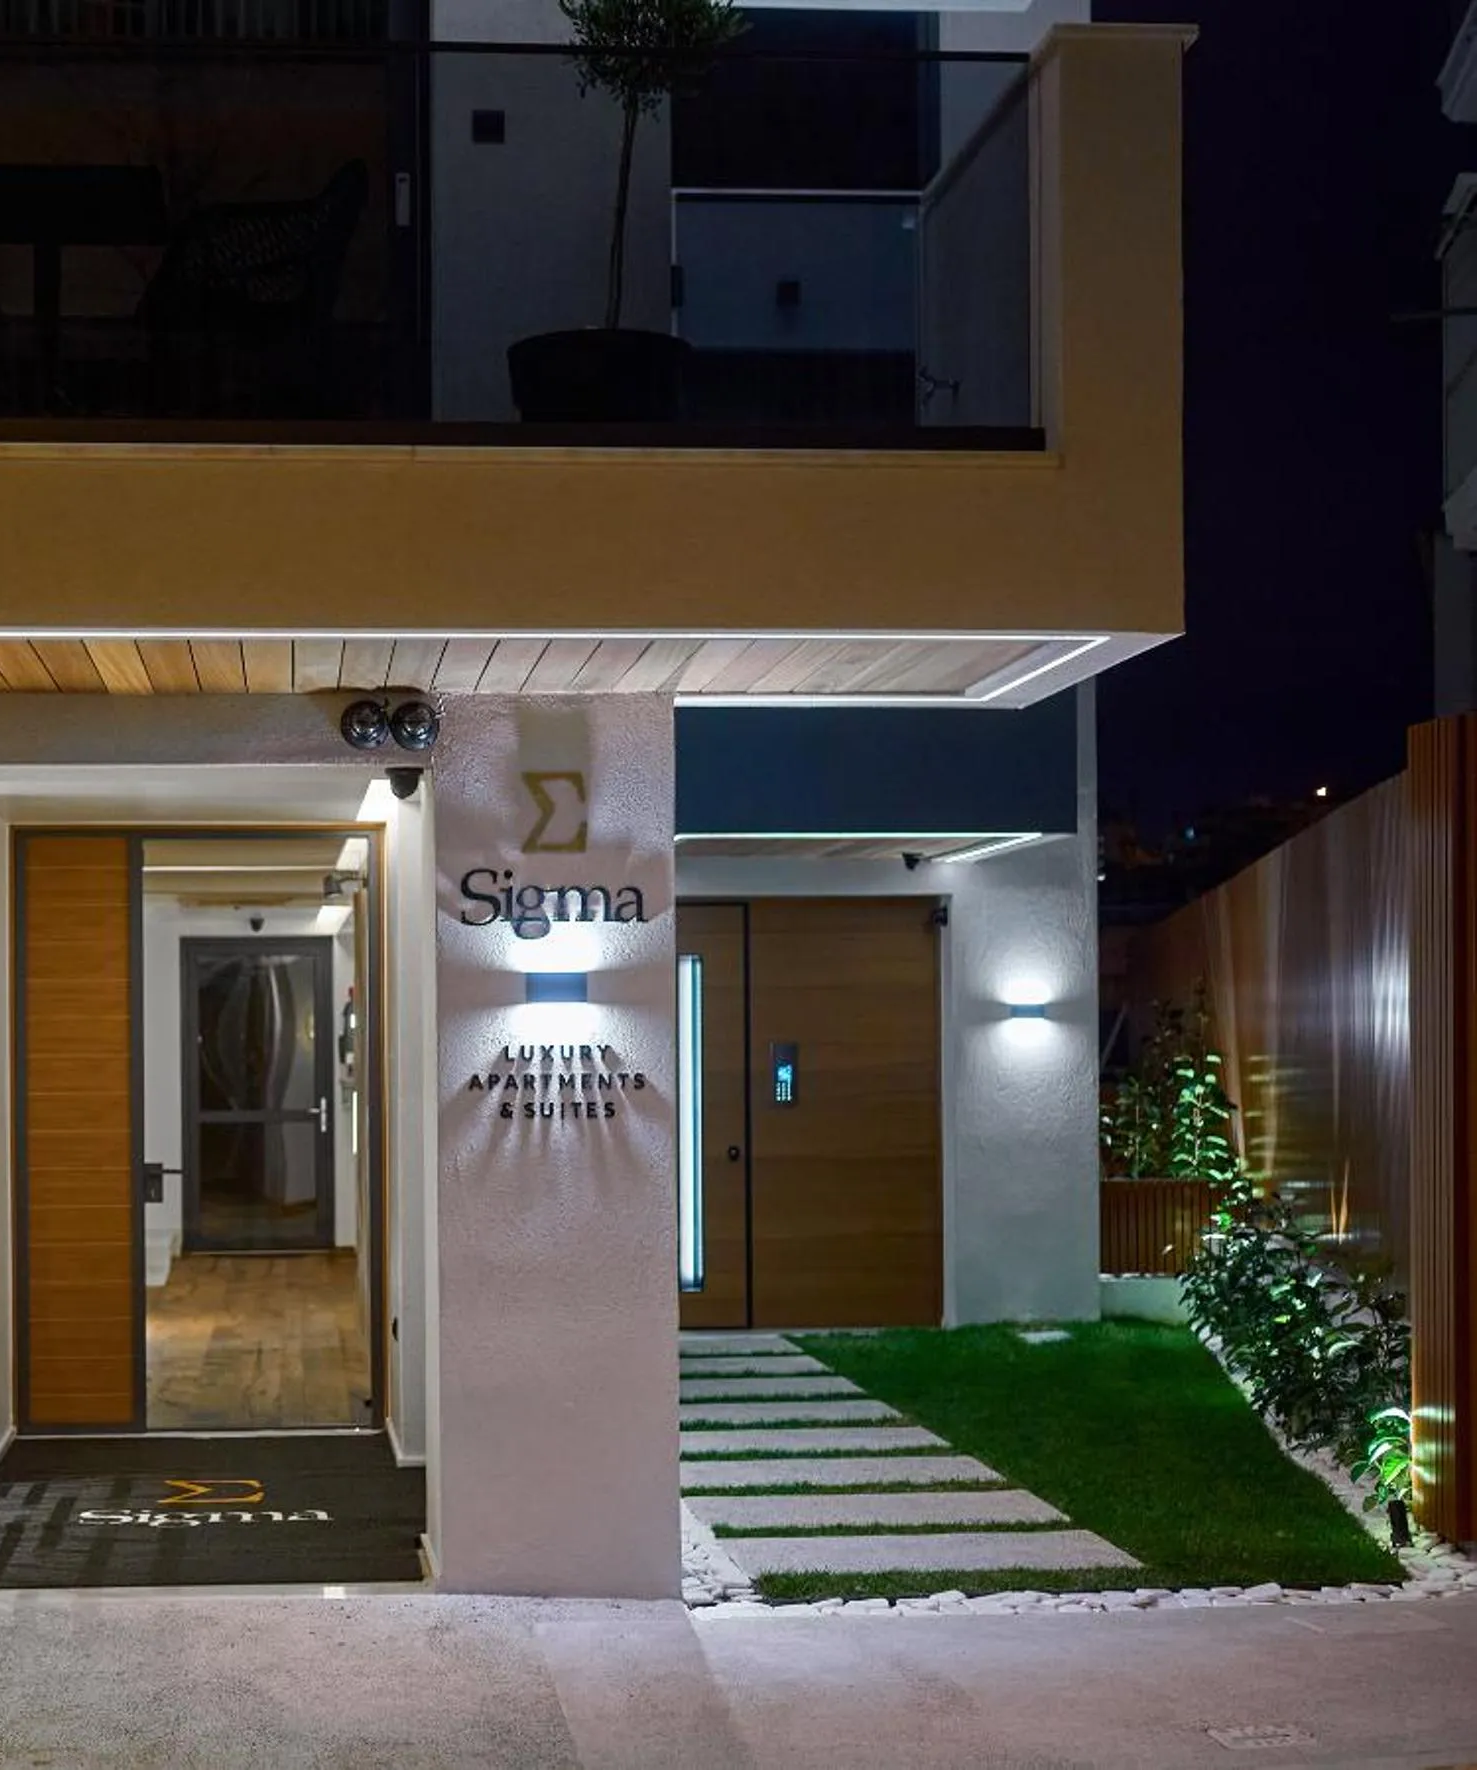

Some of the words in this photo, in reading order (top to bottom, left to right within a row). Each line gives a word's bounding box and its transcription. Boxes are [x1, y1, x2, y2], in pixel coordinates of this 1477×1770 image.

[460, 868, 648, 940] Sigma
[504, 1045, 611, 1062] LUXURY
[469, 1073, 646, 1091] APARTMENTS
[499, 1102, 514, 1119] &
[523, 1102, 616, 1119] SUITES
[77, 1508, 335, 1529] Sigma
